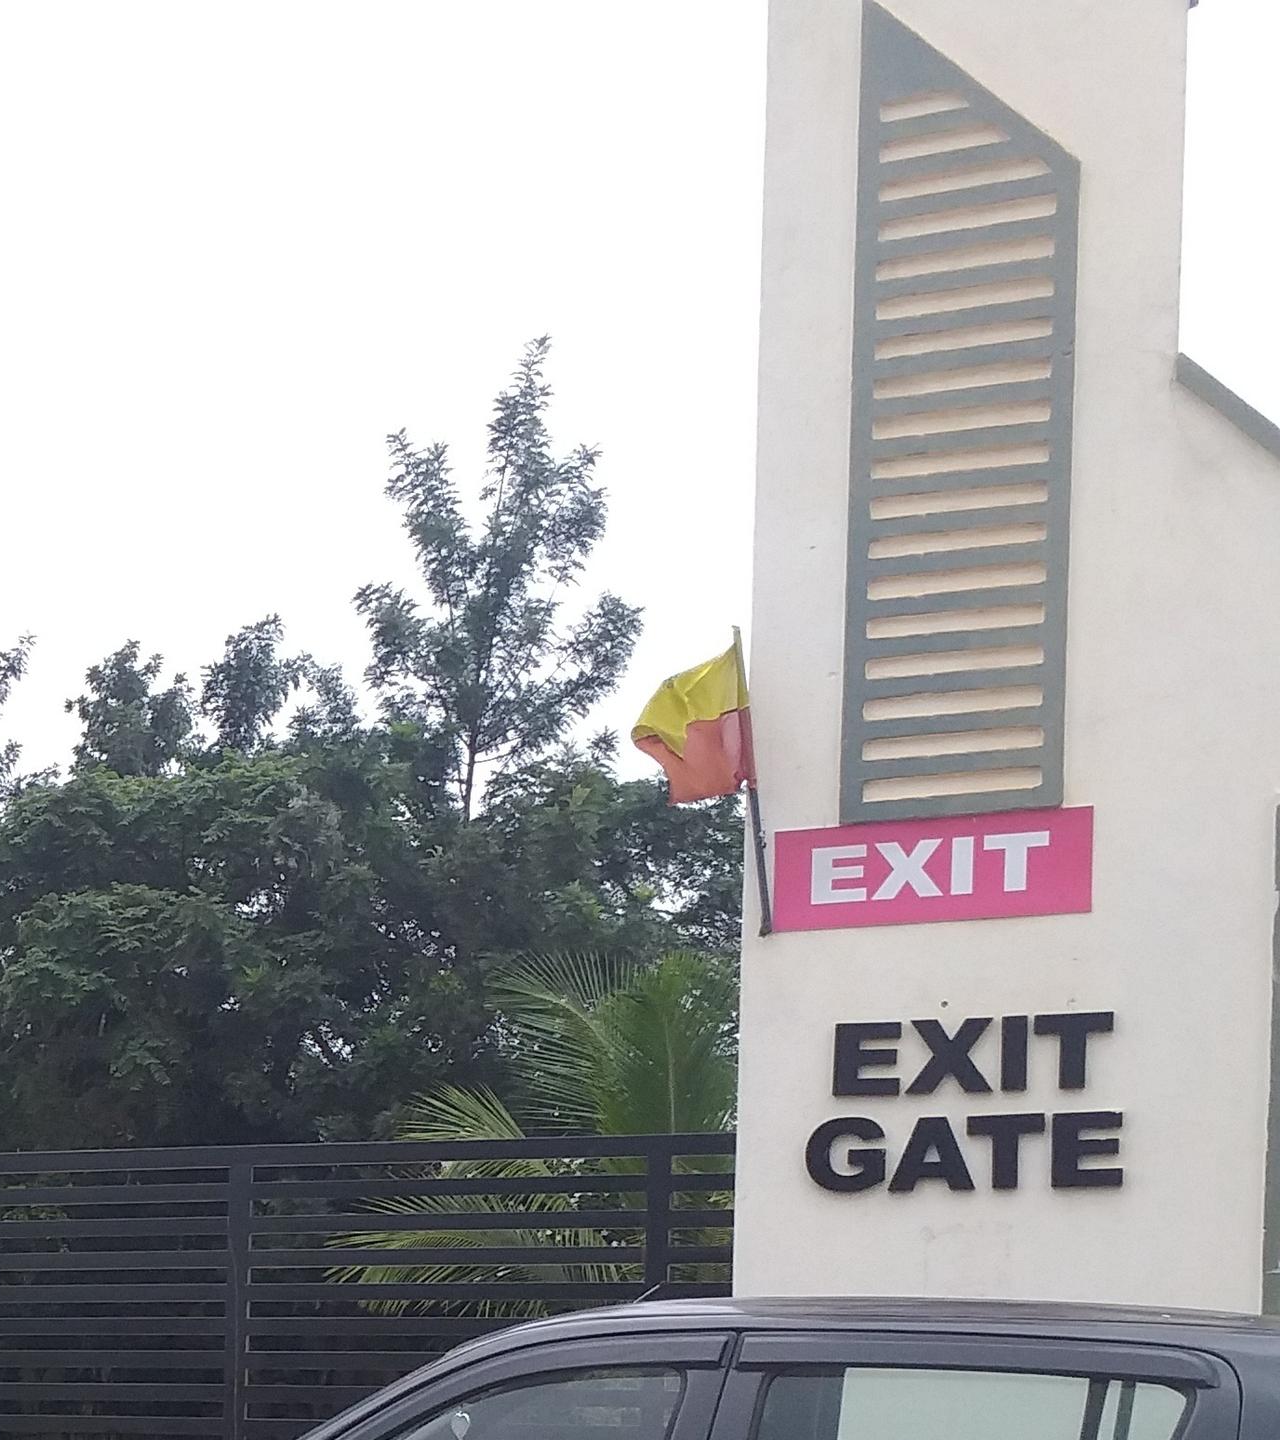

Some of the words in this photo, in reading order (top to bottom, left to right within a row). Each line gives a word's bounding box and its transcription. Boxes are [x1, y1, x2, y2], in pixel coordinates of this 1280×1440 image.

[809, 830, 1051, 905] EXIT
[832, 1011, 1115, 1097] EXIT
[805, 1110, 1125, 1193] GATE
